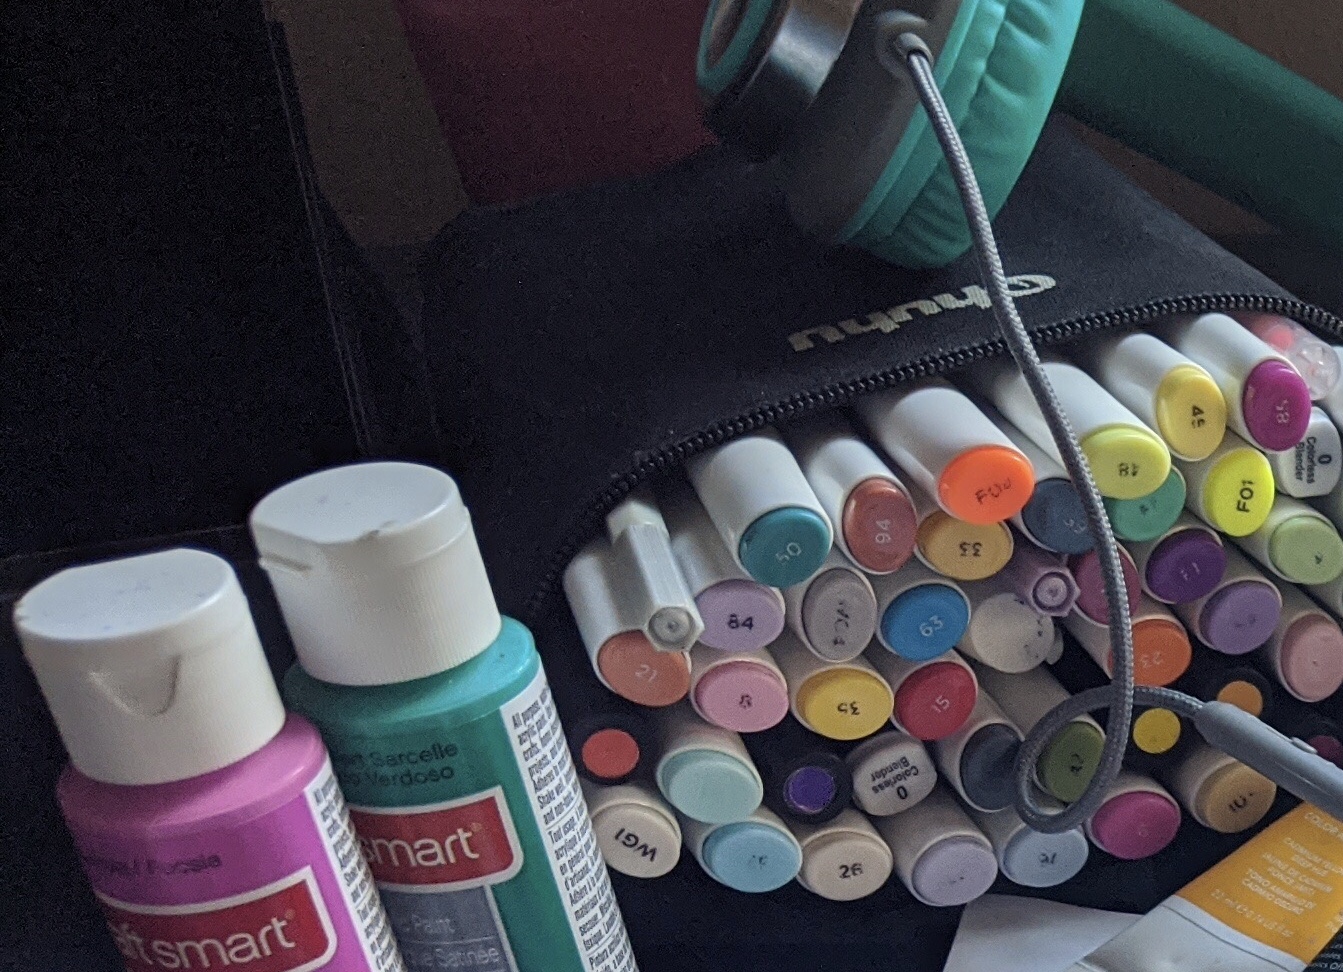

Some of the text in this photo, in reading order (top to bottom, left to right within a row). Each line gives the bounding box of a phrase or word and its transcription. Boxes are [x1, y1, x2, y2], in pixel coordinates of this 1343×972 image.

[875, 518, 891, 544] 94
[728, 613, 754, 630] 84
[934, 694, 951, 712] 15
[371, 743, 457, 767] Sarcelle
[615, 828, 658, 862] WG1
[153, 917, 296, 968] smart
